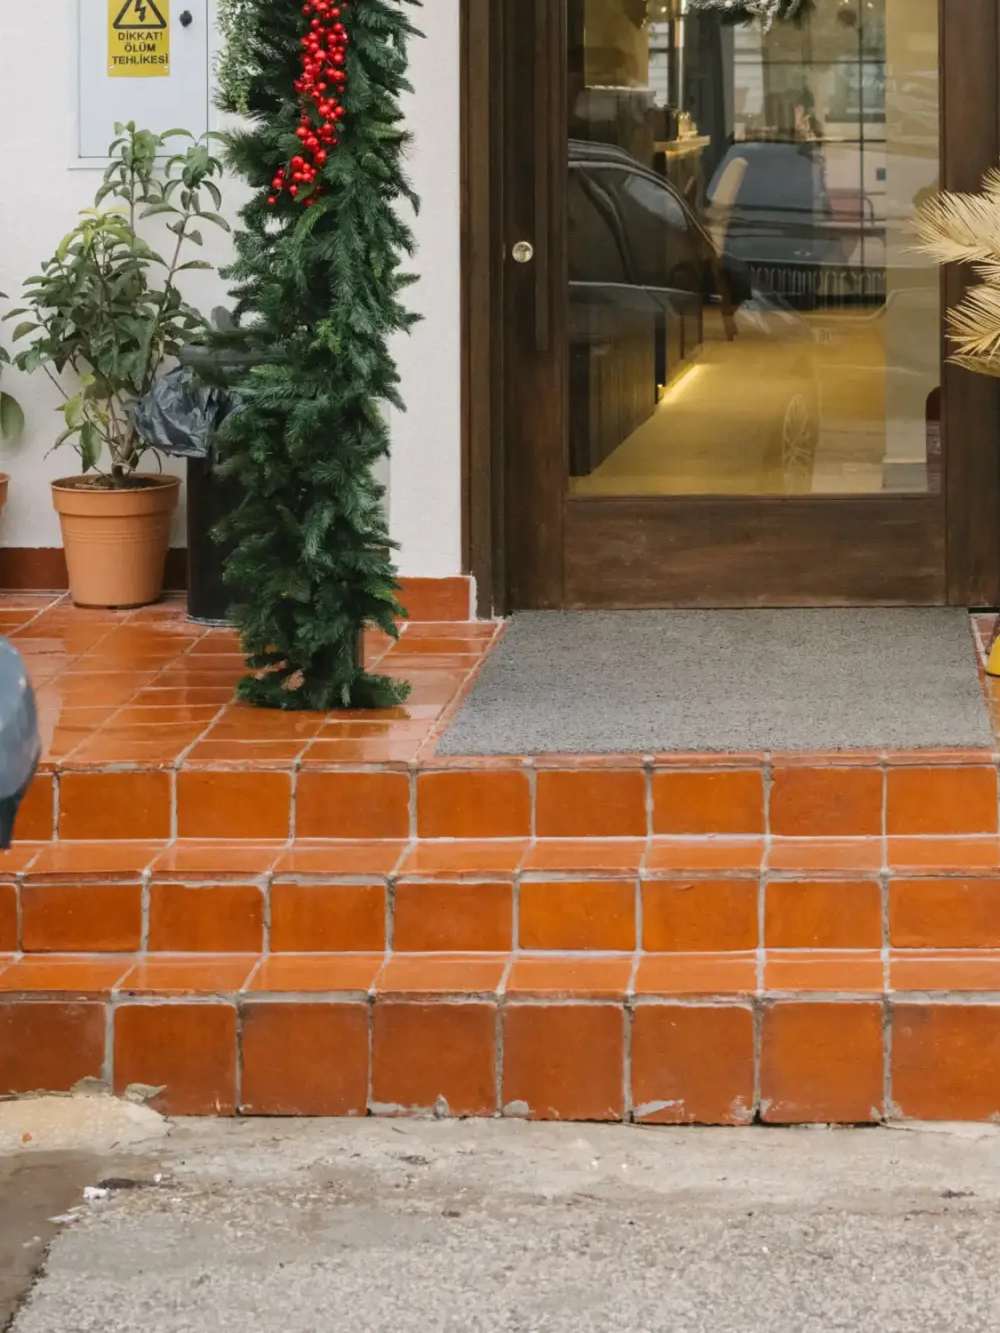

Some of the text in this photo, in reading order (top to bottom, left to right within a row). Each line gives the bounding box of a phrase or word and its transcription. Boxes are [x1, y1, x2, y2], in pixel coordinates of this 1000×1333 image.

[117, 30, 163, 41] DİKKAT!
[124, 42, 156, 53] ÖLÜM
[112, 53, 169, 65] TEHLİKESİ
